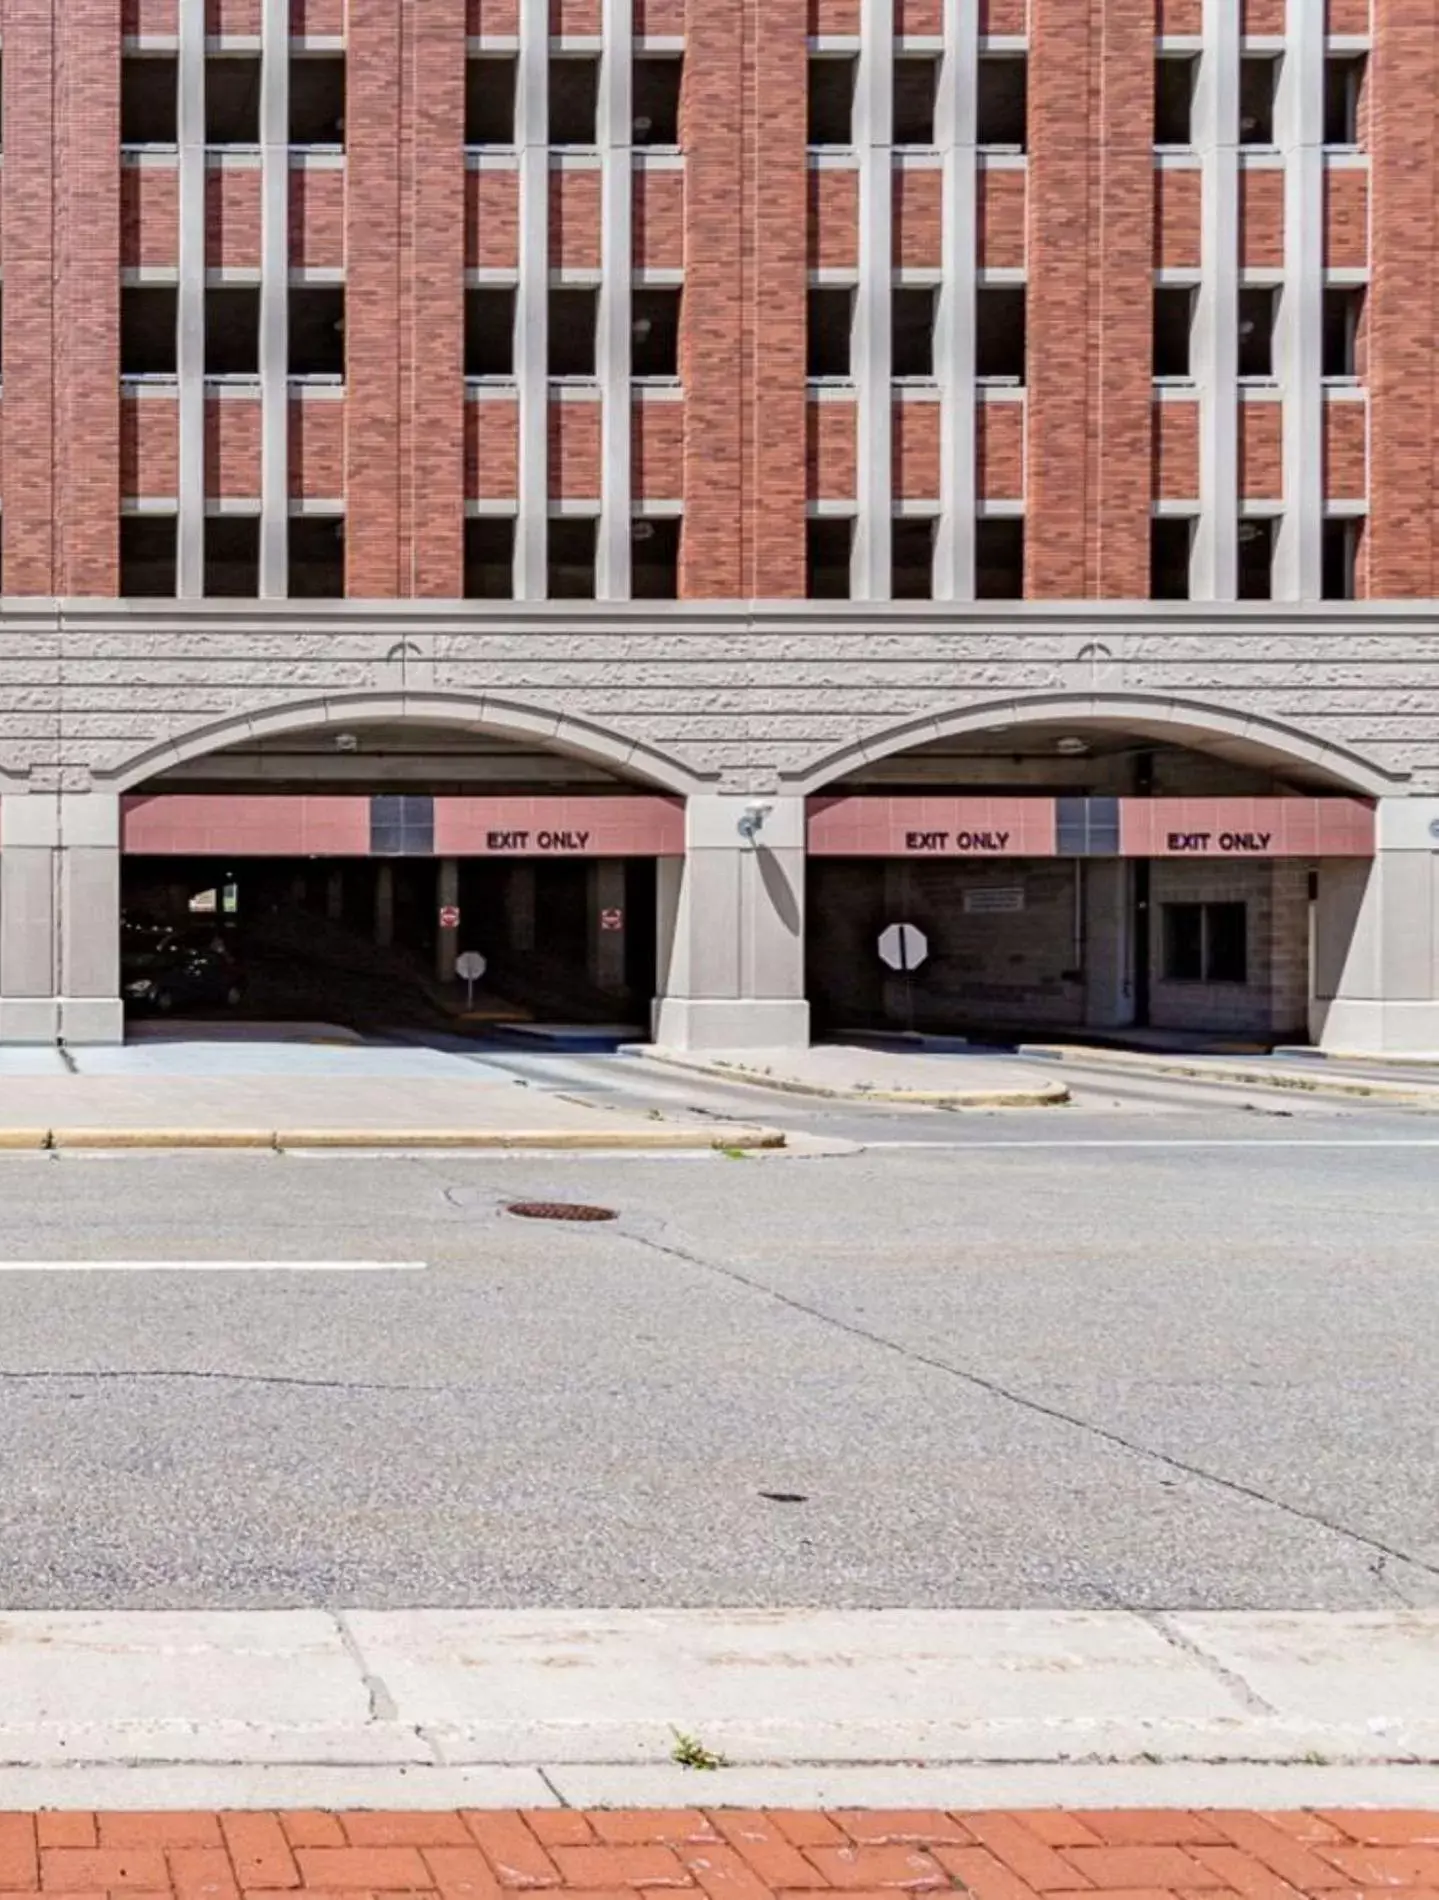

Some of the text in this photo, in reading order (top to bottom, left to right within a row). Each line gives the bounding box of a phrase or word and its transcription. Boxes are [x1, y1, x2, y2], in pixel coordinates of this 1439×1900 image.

[486, 831, 590, 850] EXIT ONLY
[905, 831, 1010, 850] EXIT ONLY
[1167, 832, 1271, 851] EXIT ONLY
